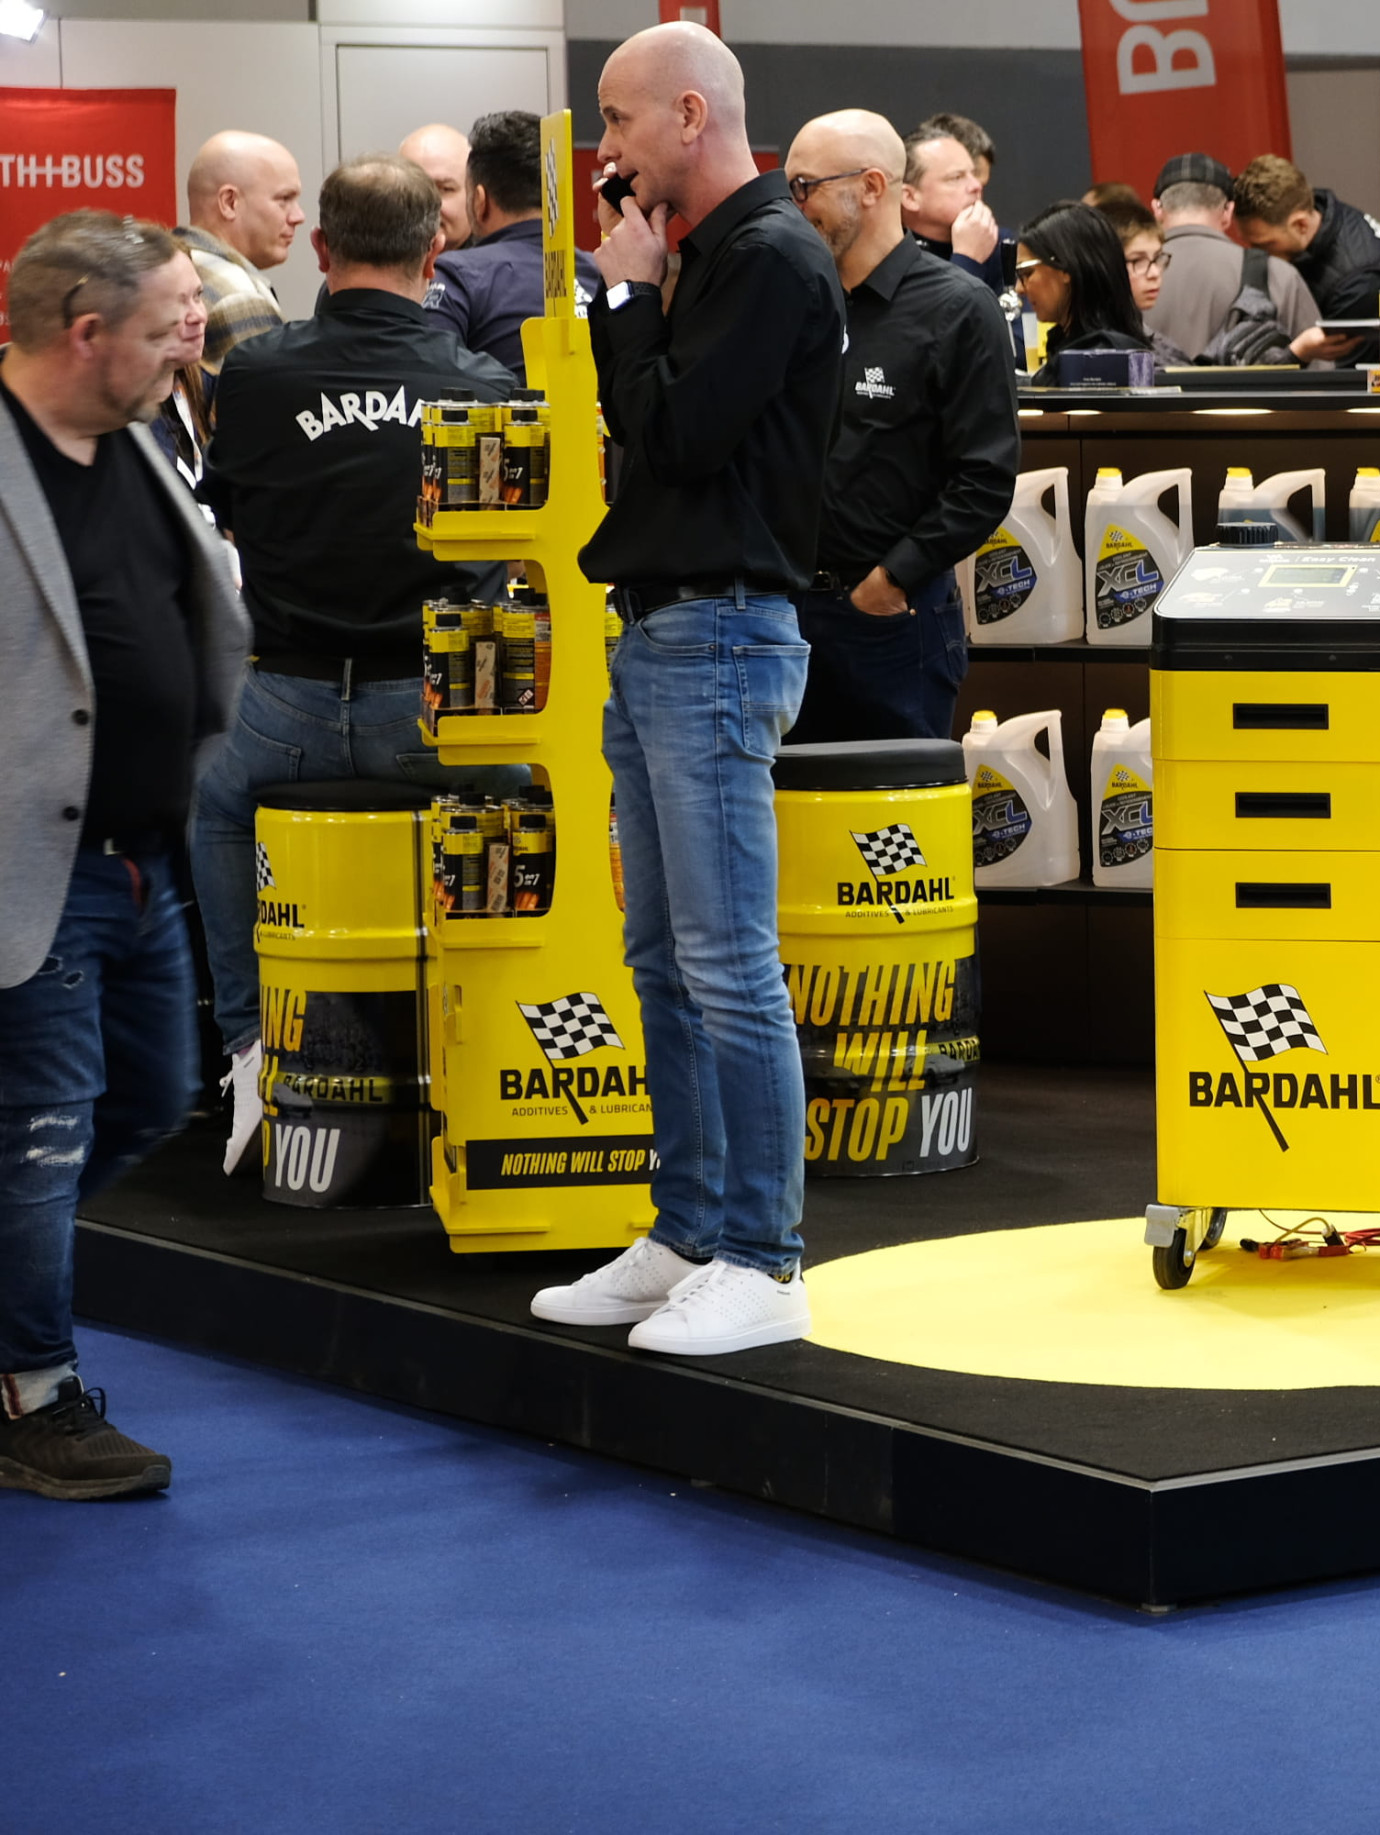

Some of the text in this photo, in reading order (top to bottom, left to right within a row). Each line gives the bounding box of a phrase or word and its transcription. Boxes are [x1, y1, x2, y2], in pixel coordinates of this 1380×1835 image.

[855, 381, 895, 396] BARDAHL
[976, 556, 1032, 593] XCL
[1096, 559, 1159, 598] XCL
[973, 800, 1028, 836] XCL
[837, 876, 955, 906] BARDAHL
[260, 900, 305, 928] DAHL
[788, 961, 957, 1027] NOTHING
[834, 1030, 927, 1092] WILL
[500, 1066, 651, 1100] BARDAH
[512, 1104, 652, 1117] ADDITIVES & LUBRICAN
[804, 1087, 972, 1161] STOP YOU
[275, 1123, 341, 1193] YOU
[501, 1152, 567, 1176] NOTHING
[571, 1151, 604, 1174] WILL
[608, 1149, 645, 1173] STOP
